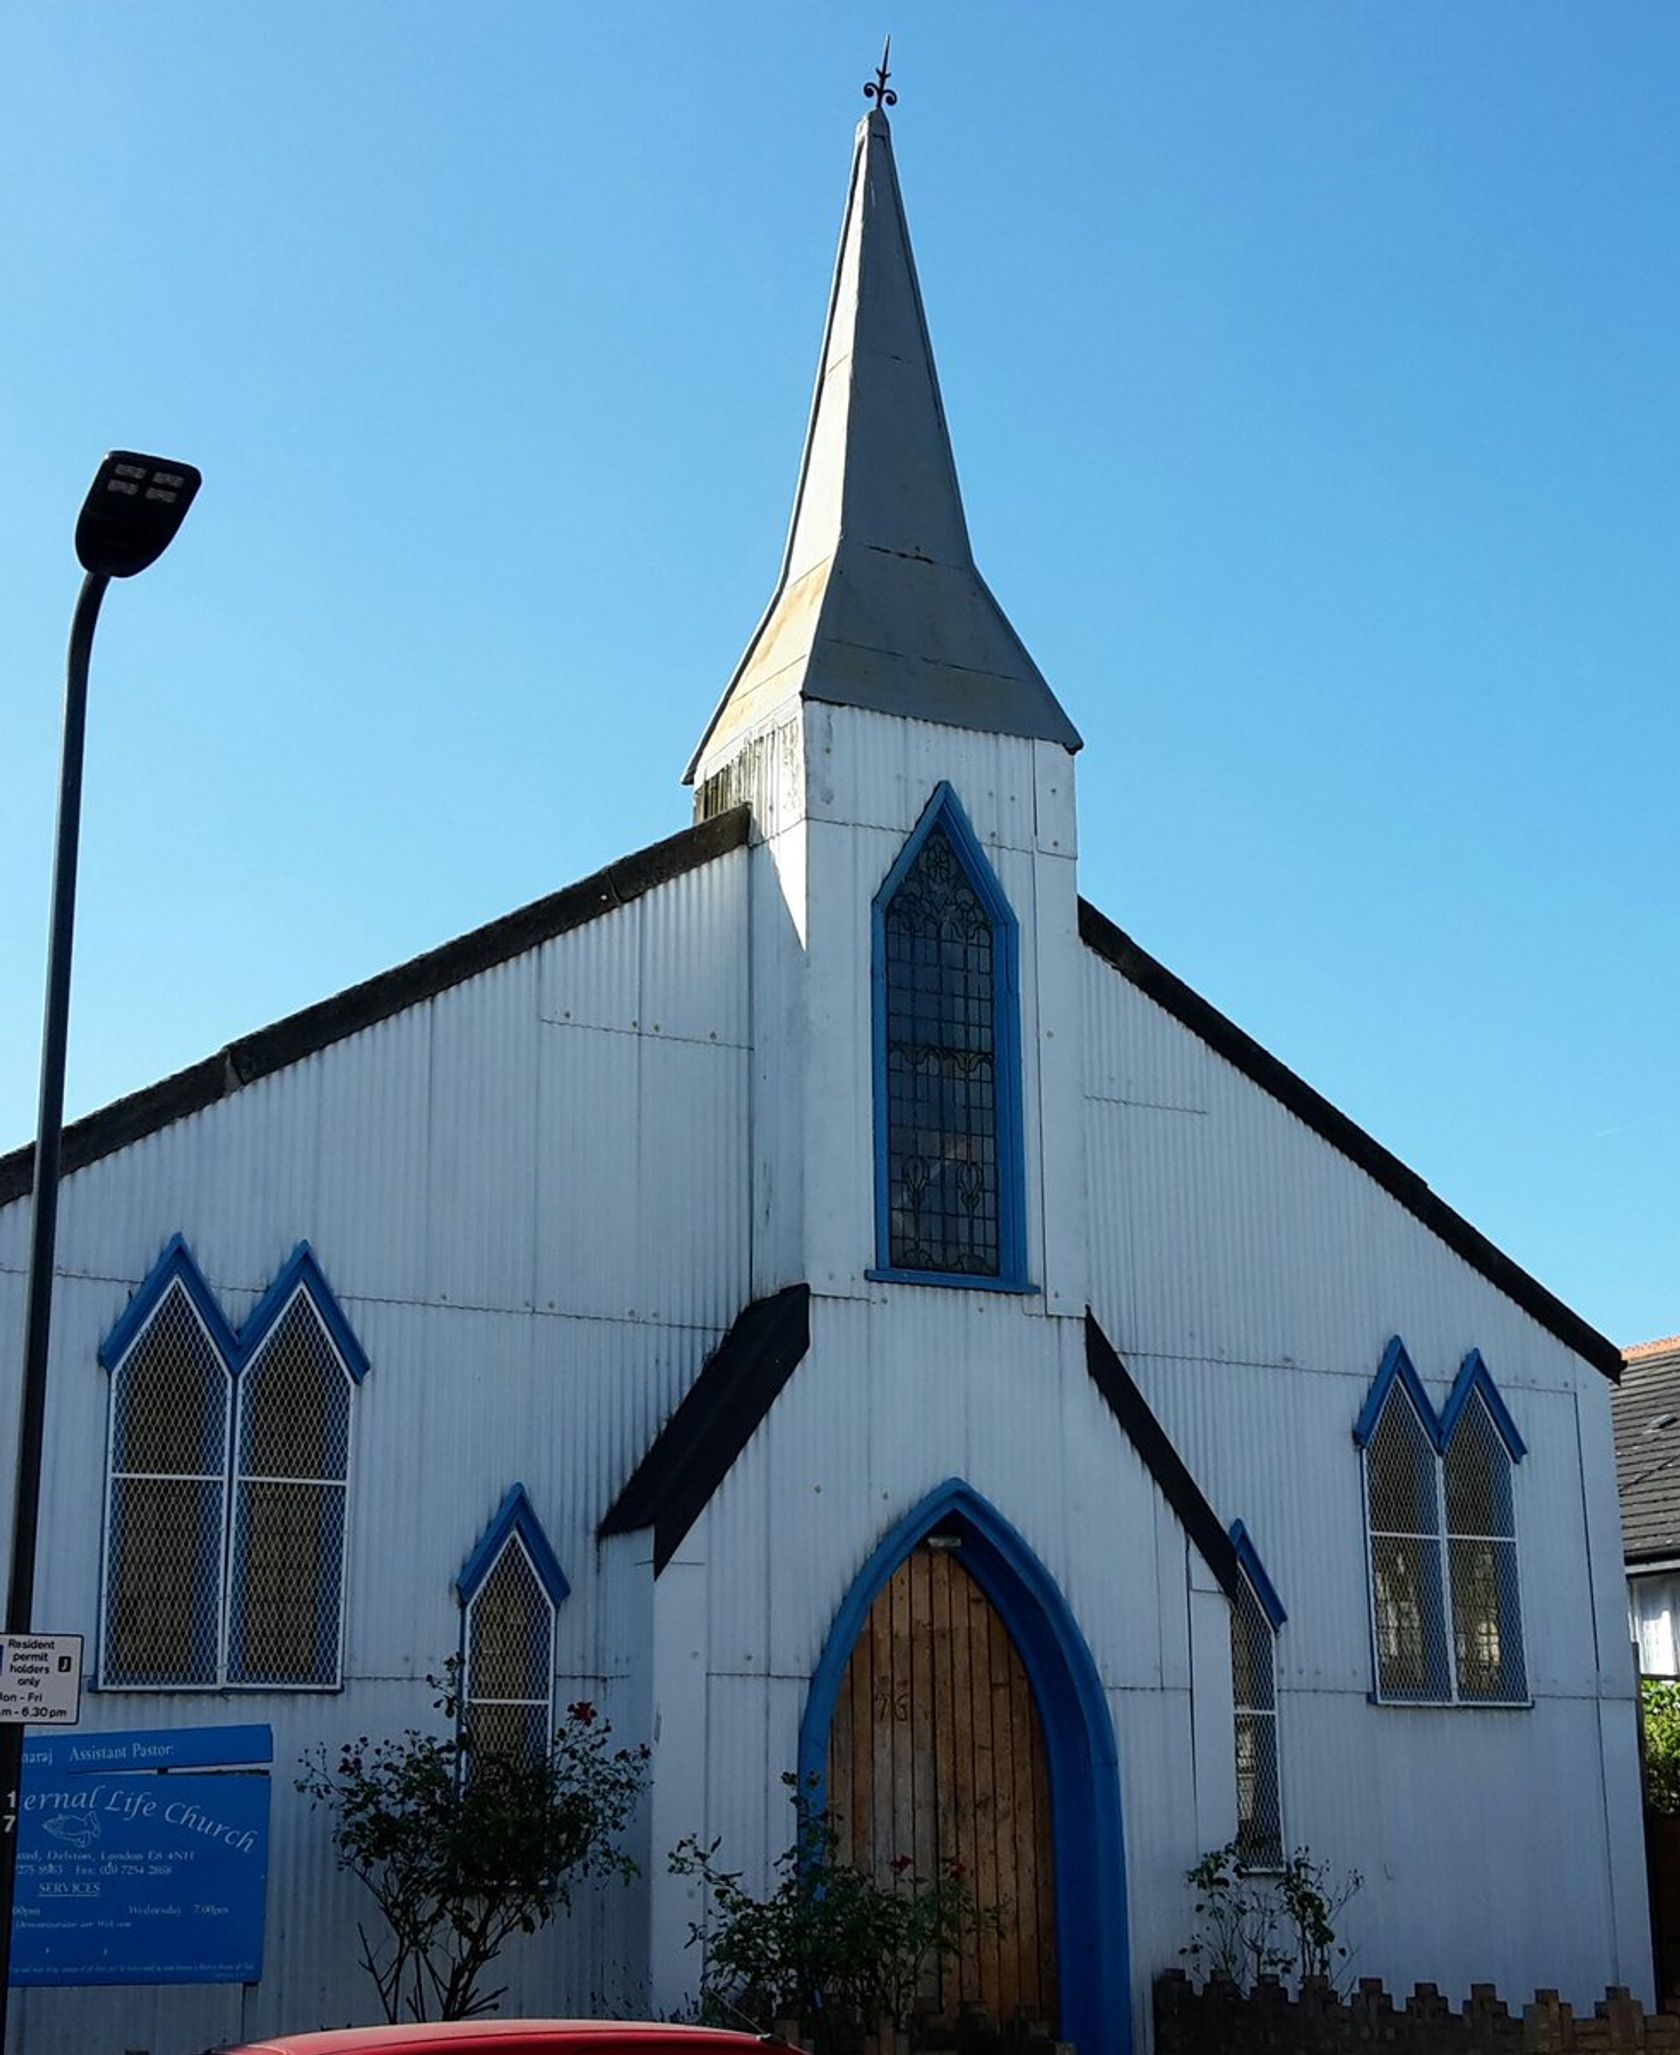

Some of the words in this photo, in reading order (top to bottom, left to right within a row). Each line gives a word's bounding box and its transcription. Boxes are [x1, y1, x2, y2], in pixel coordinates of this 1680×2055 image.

[8, 1639, 55, 1650] Resident
[12, 1652, 49, 1662] permit
[9, 1664, 50, 1674] holders
[17, 1676, 40, 1688] only
[27, 1692, 43, 1702] Fri
[21, 1706, 48, 1717] 6.30
[49, 1708, 67, 1719] pm
[69, 1743, 127, 1762] Assistant
[23, 1785, 107, 1811] ernal
[104, 1790, 158, 1822] Life
[164, 1802, 259, 1853] Church
[100, 1851, 144, 1861] London
[40, 1882, 101, 1894] SERVICES
